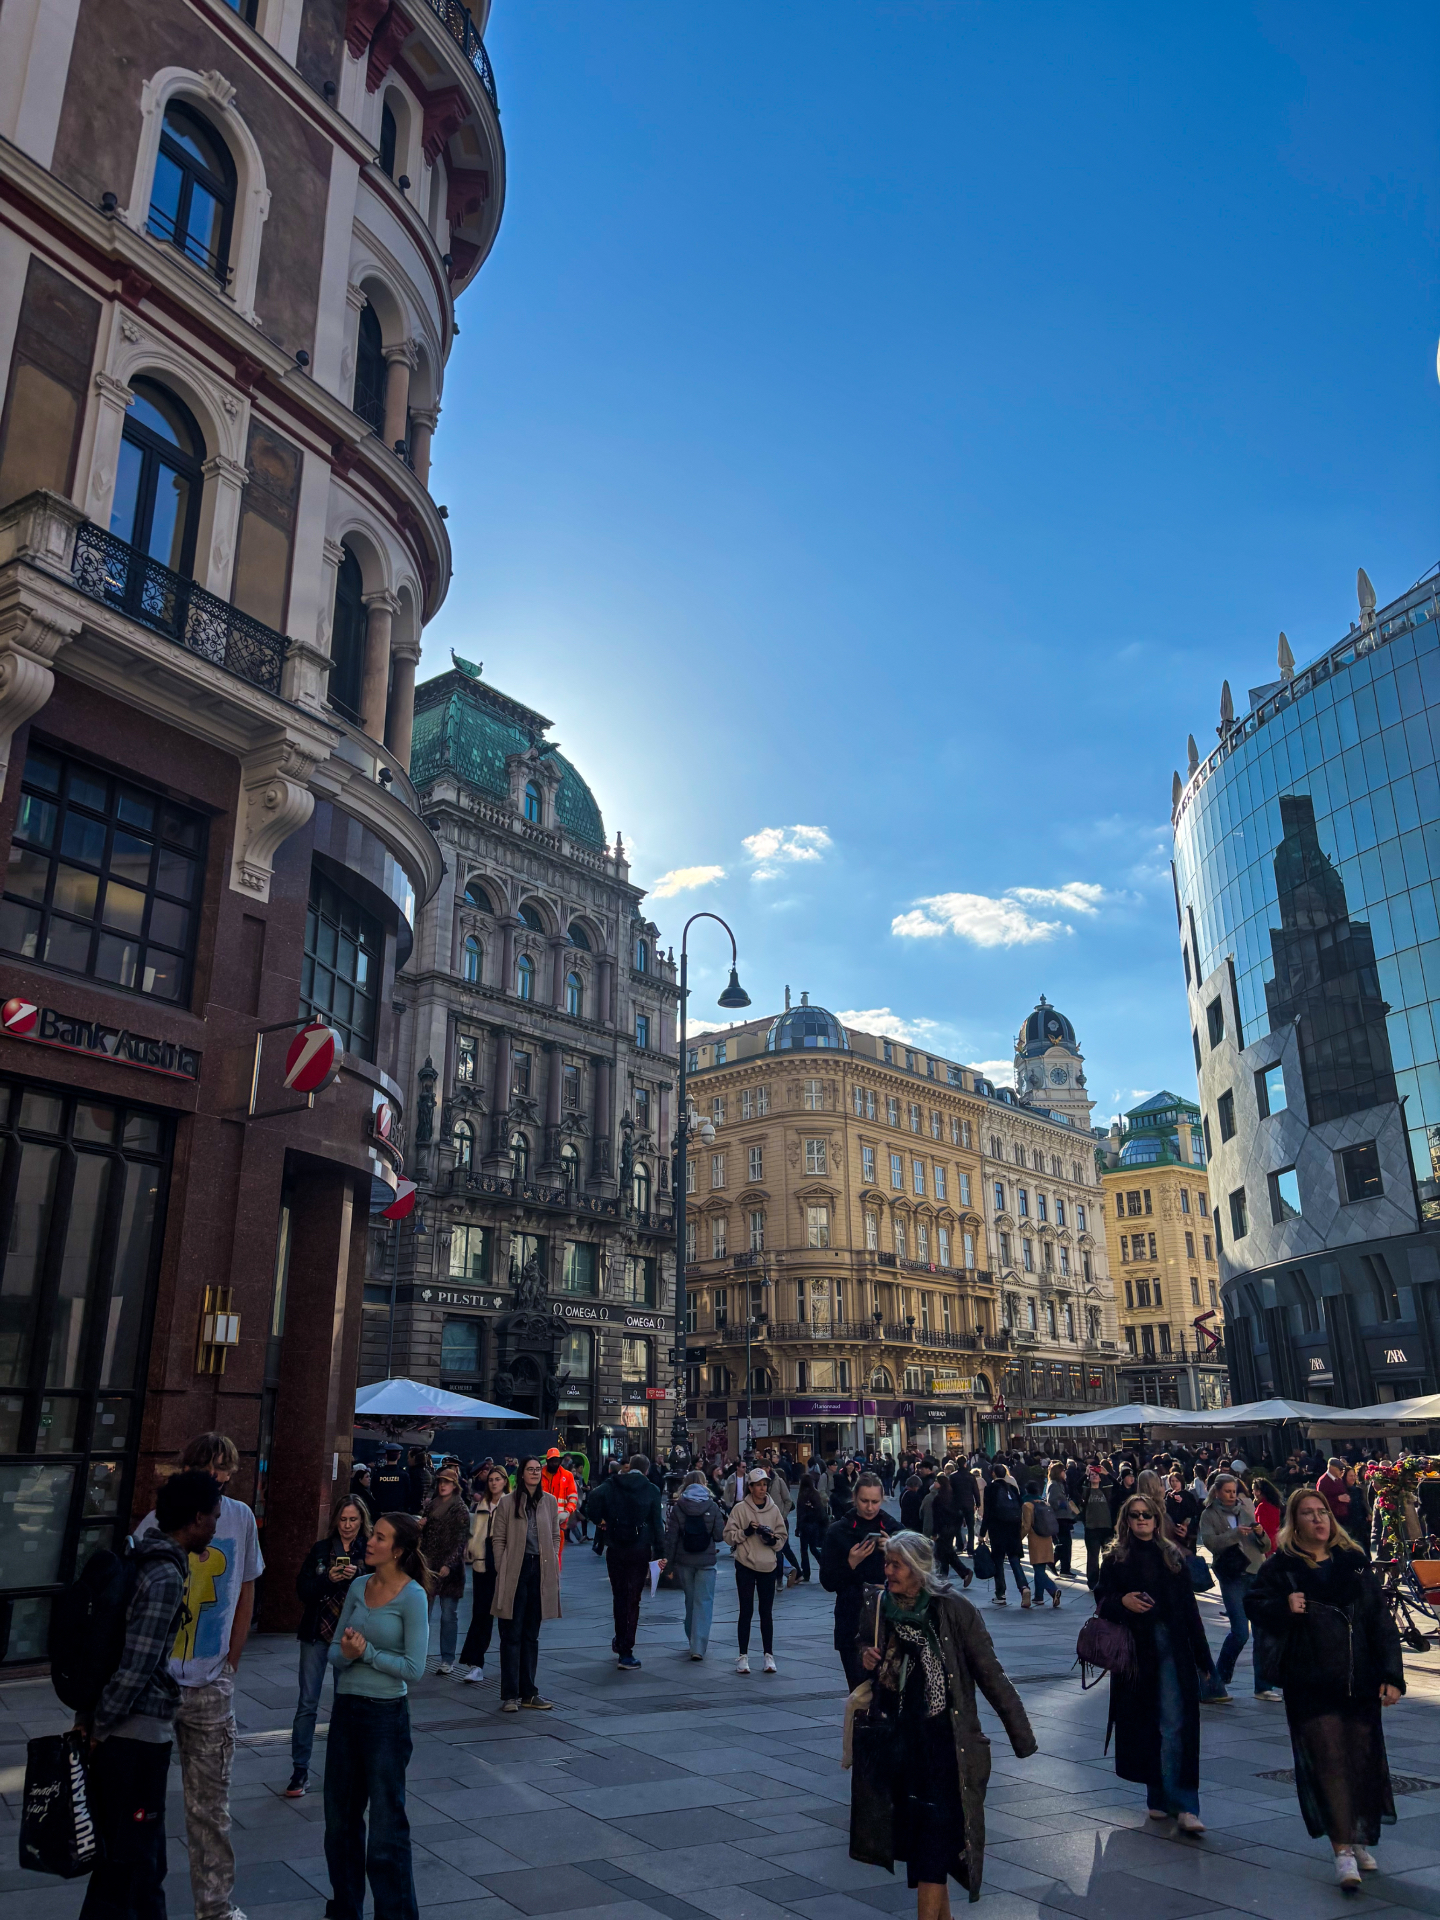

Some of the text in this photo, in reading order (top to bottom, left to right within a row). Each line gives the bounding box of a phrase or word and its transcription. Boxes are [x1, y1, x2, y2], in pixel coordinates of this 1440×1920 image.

[38, 1007, 196, 1074] Bank Austria
[438, 1291, 489, 1307] PILSTL
[565, 1305, 597, 1319] OMEGA
[626, 1316, 655, 1328] OMEGA
[1309, 1357, 1326, 1371] ZARA
[1384, 1348, 1408, 1364] ZARA
[69, 1751, 96, 1855] HUMANIC
